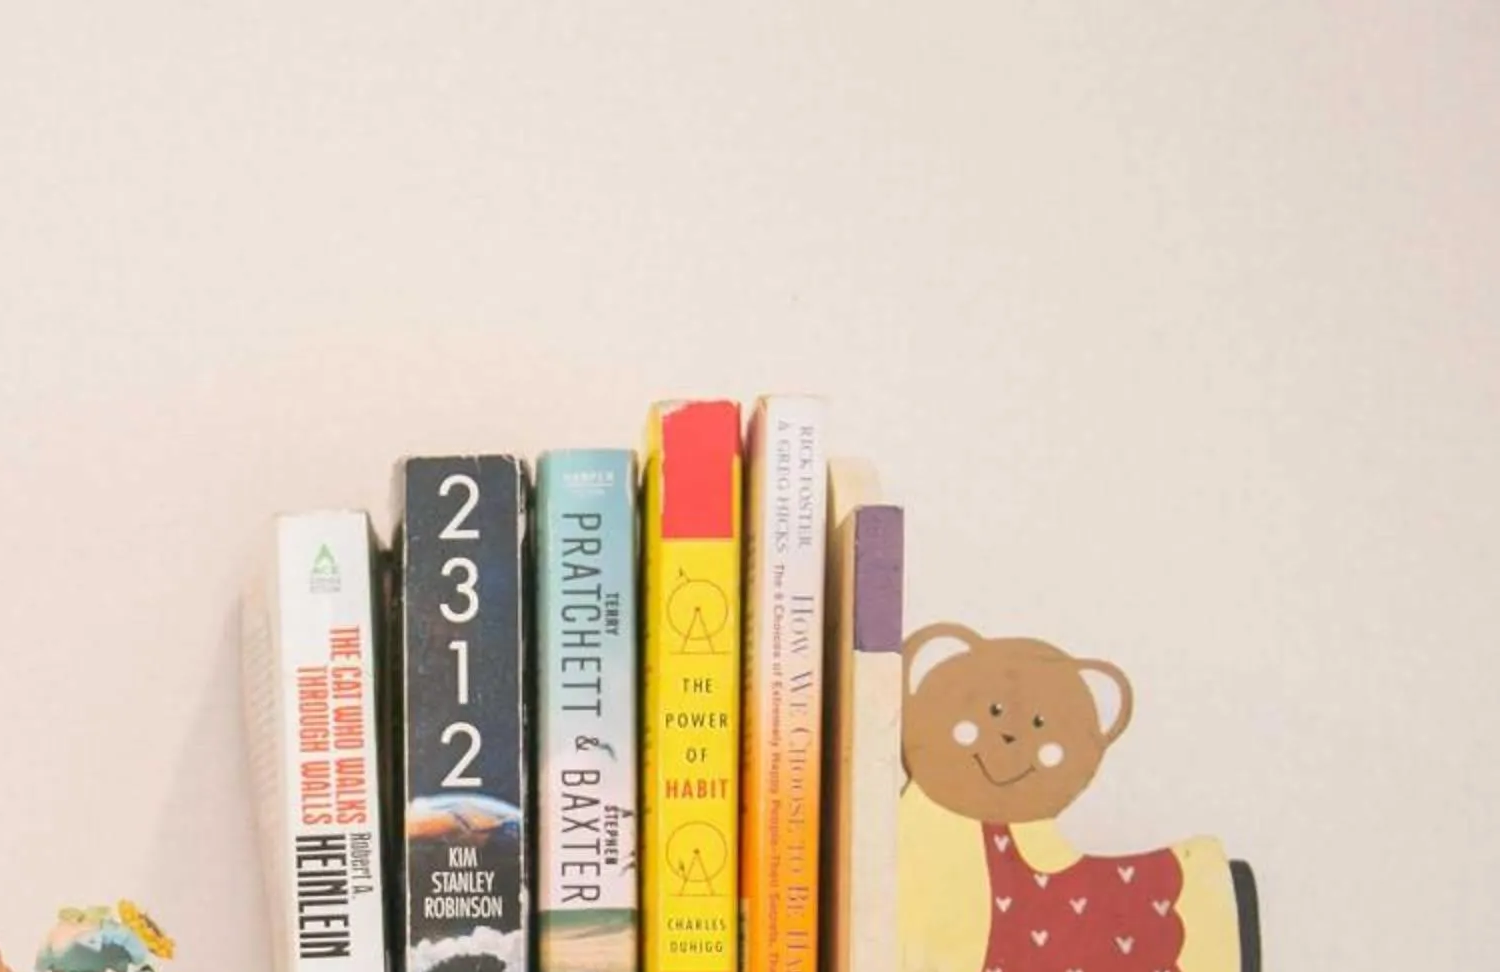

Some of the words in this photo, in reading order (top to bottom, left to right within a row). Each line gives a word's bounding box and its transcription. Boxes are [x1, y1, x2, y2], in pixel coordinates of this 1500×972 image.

[775, 439, 791, 491] GREG
[800, 425, 814, 470] RICK
[774, 497, 790, 554] HICKS
[798, 476, 813, 548] FOSTER
[773, 564, 785, 589] The
[561, 512, 602, 717] PRATCHETT
[605, 592, 620, 636] TERRY
[772, 606, 785, 659] Choices
[329, 625, 362, 661] THE
[331, 666, 363, 699] CAT
[682, 678, 713, 694] THE
[296, 665, 330, 752] THROUGH
[333, 706, 364, 750] WHO
[665, 713, 728, 729] POWER
[769, 681, 783, 747] Extremely
[575, 735, 600, 752] &
[686, 748, 708, 763] OF
[300, 760, 332, 825] WALLS
[334, 757, 367, 824] WALKS
[665, 778, 729, 800] HABIT
[768, 752, 781, 794] Happy
[449, 847, 478, 868] KIM
[561, 769, 601, 903] BAXTER
[603, 805, 619, 866] STEPHEN
[295, 834, 351, 959] HEINLEIN
[431, 871, 495, 893] STANLEY
[424, 896, 503, 919] ROBINSON
[666, 918, 727, 932] CHARLES
[669, 941, 724, 954] DUHIGG
